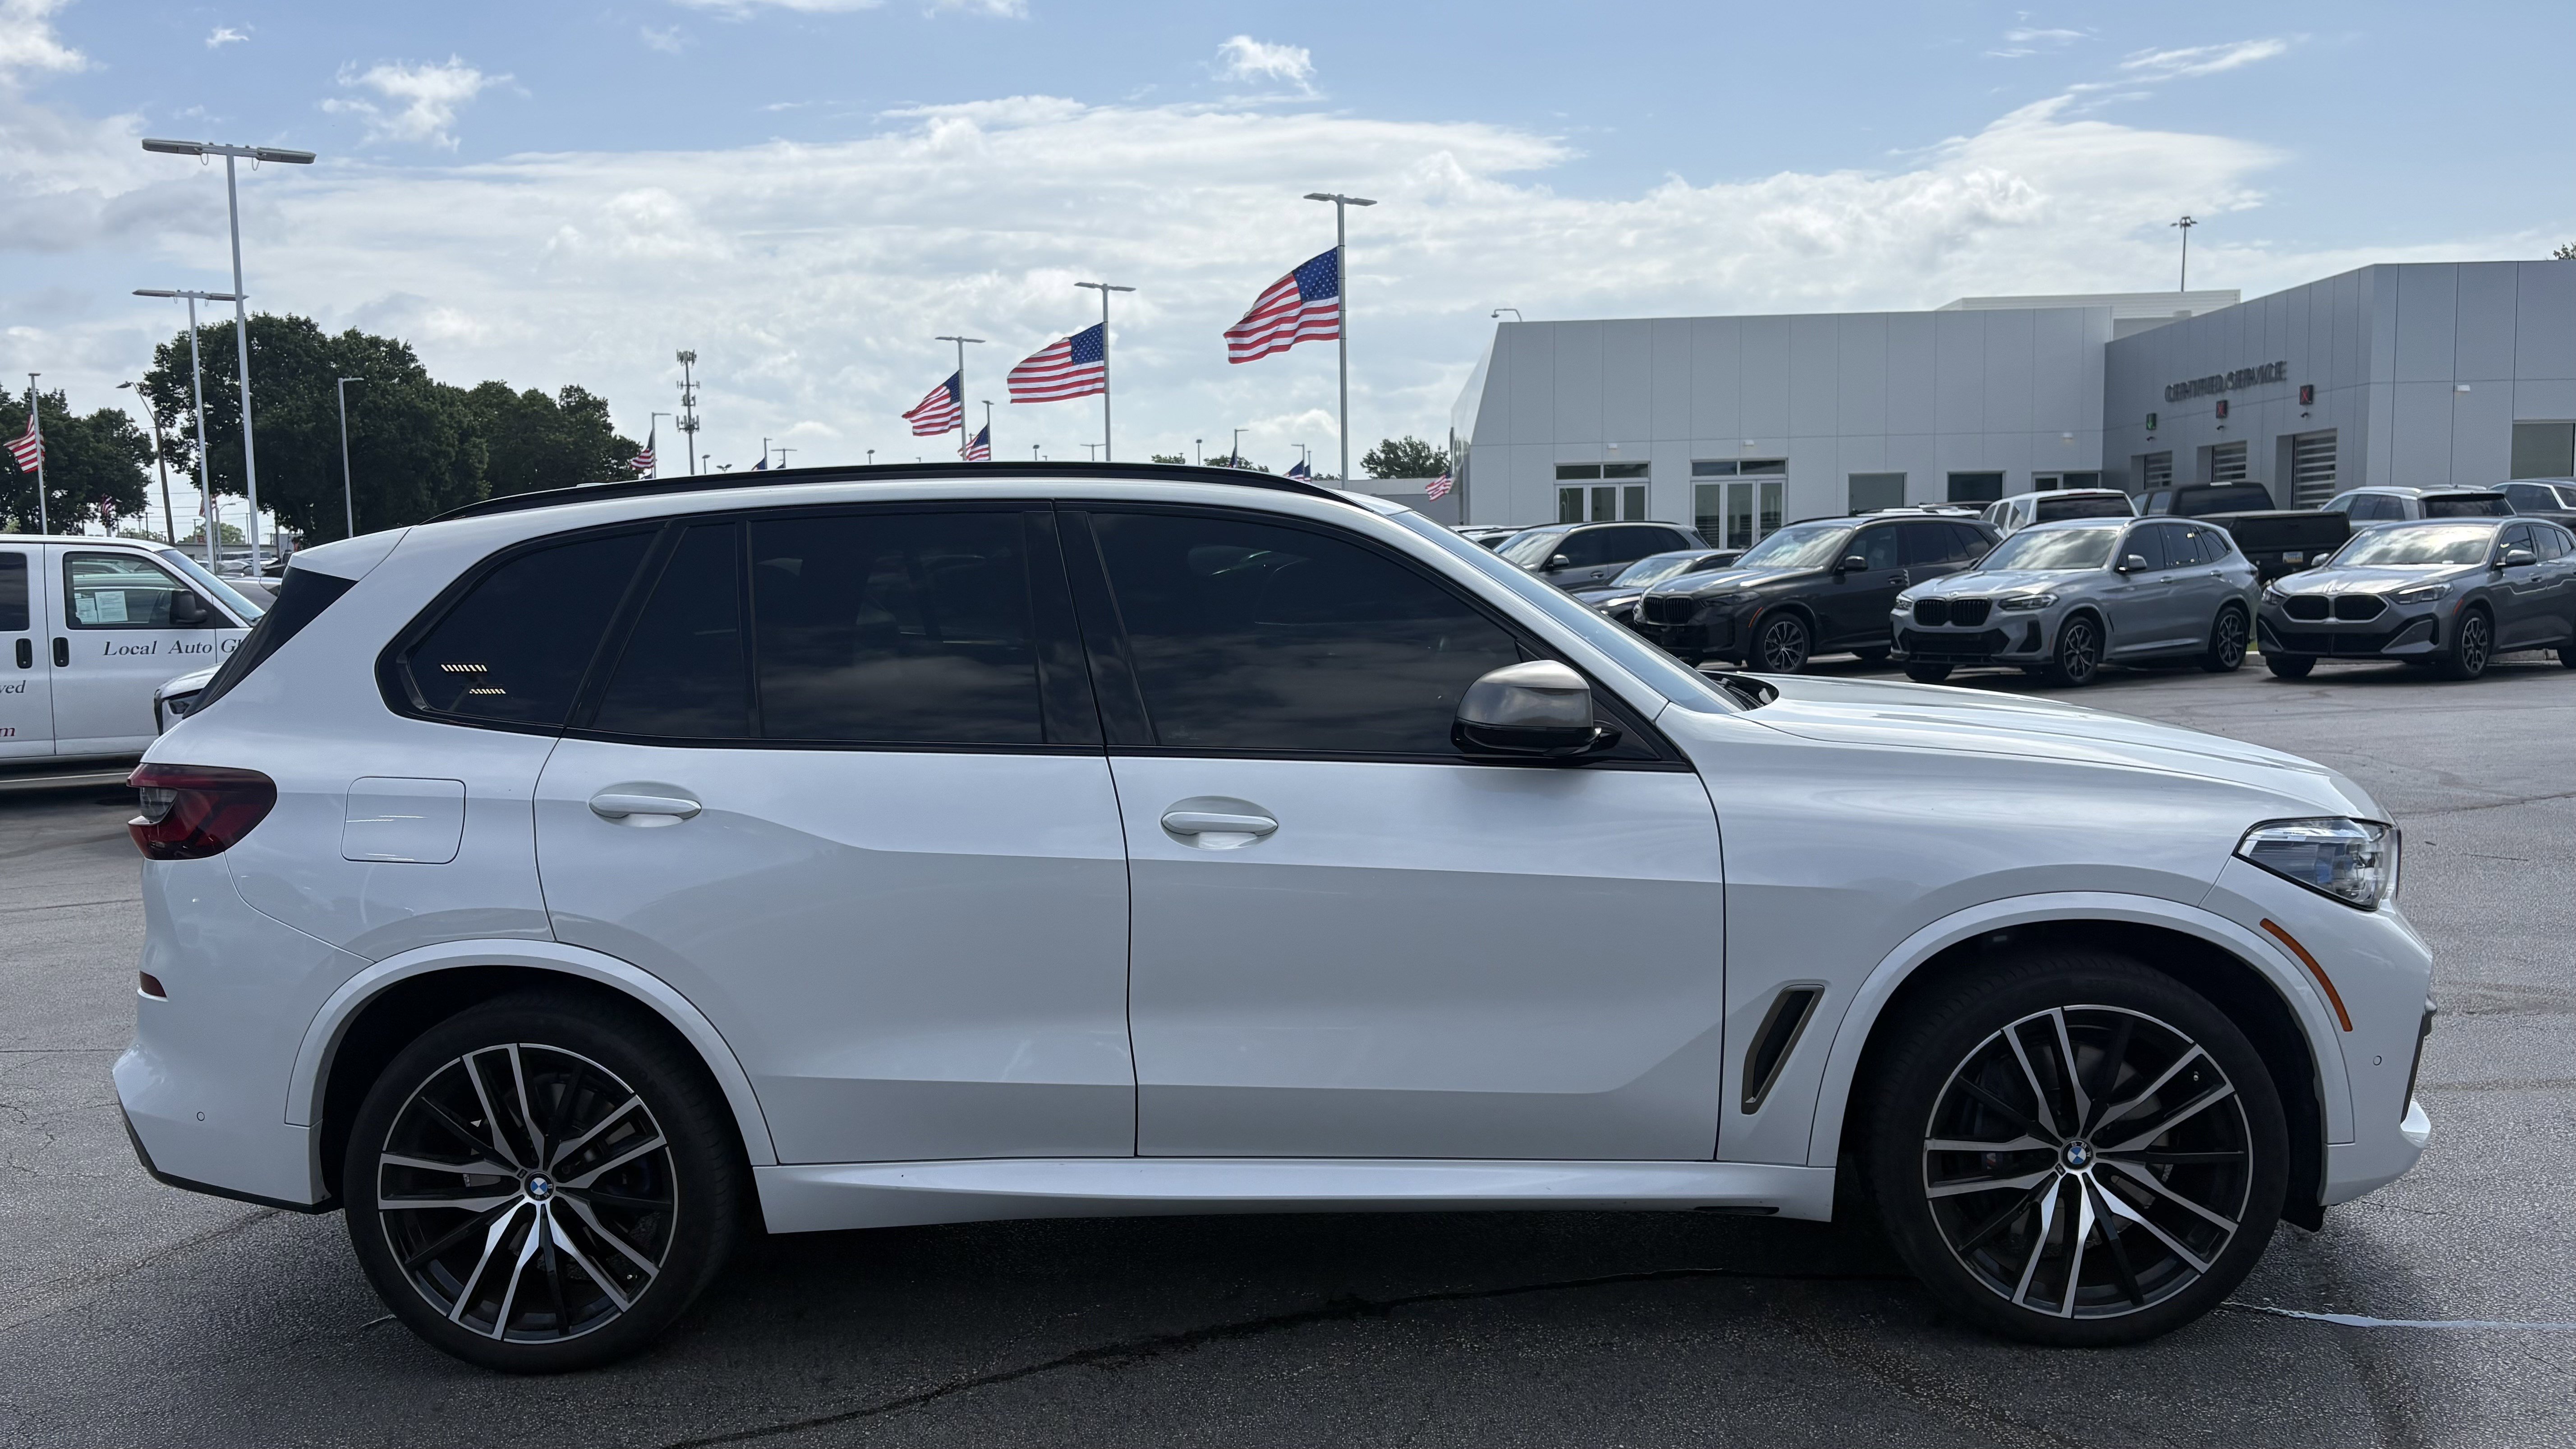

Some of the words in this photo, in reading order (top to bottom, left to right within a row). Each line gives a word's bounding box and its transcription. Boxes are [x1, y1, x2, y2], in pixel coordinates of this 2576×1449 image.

[2226, 360, 2287, 390] SERVICE
[103, 640, 157, 656] Local
[167, 639, 212, 654] Auto
